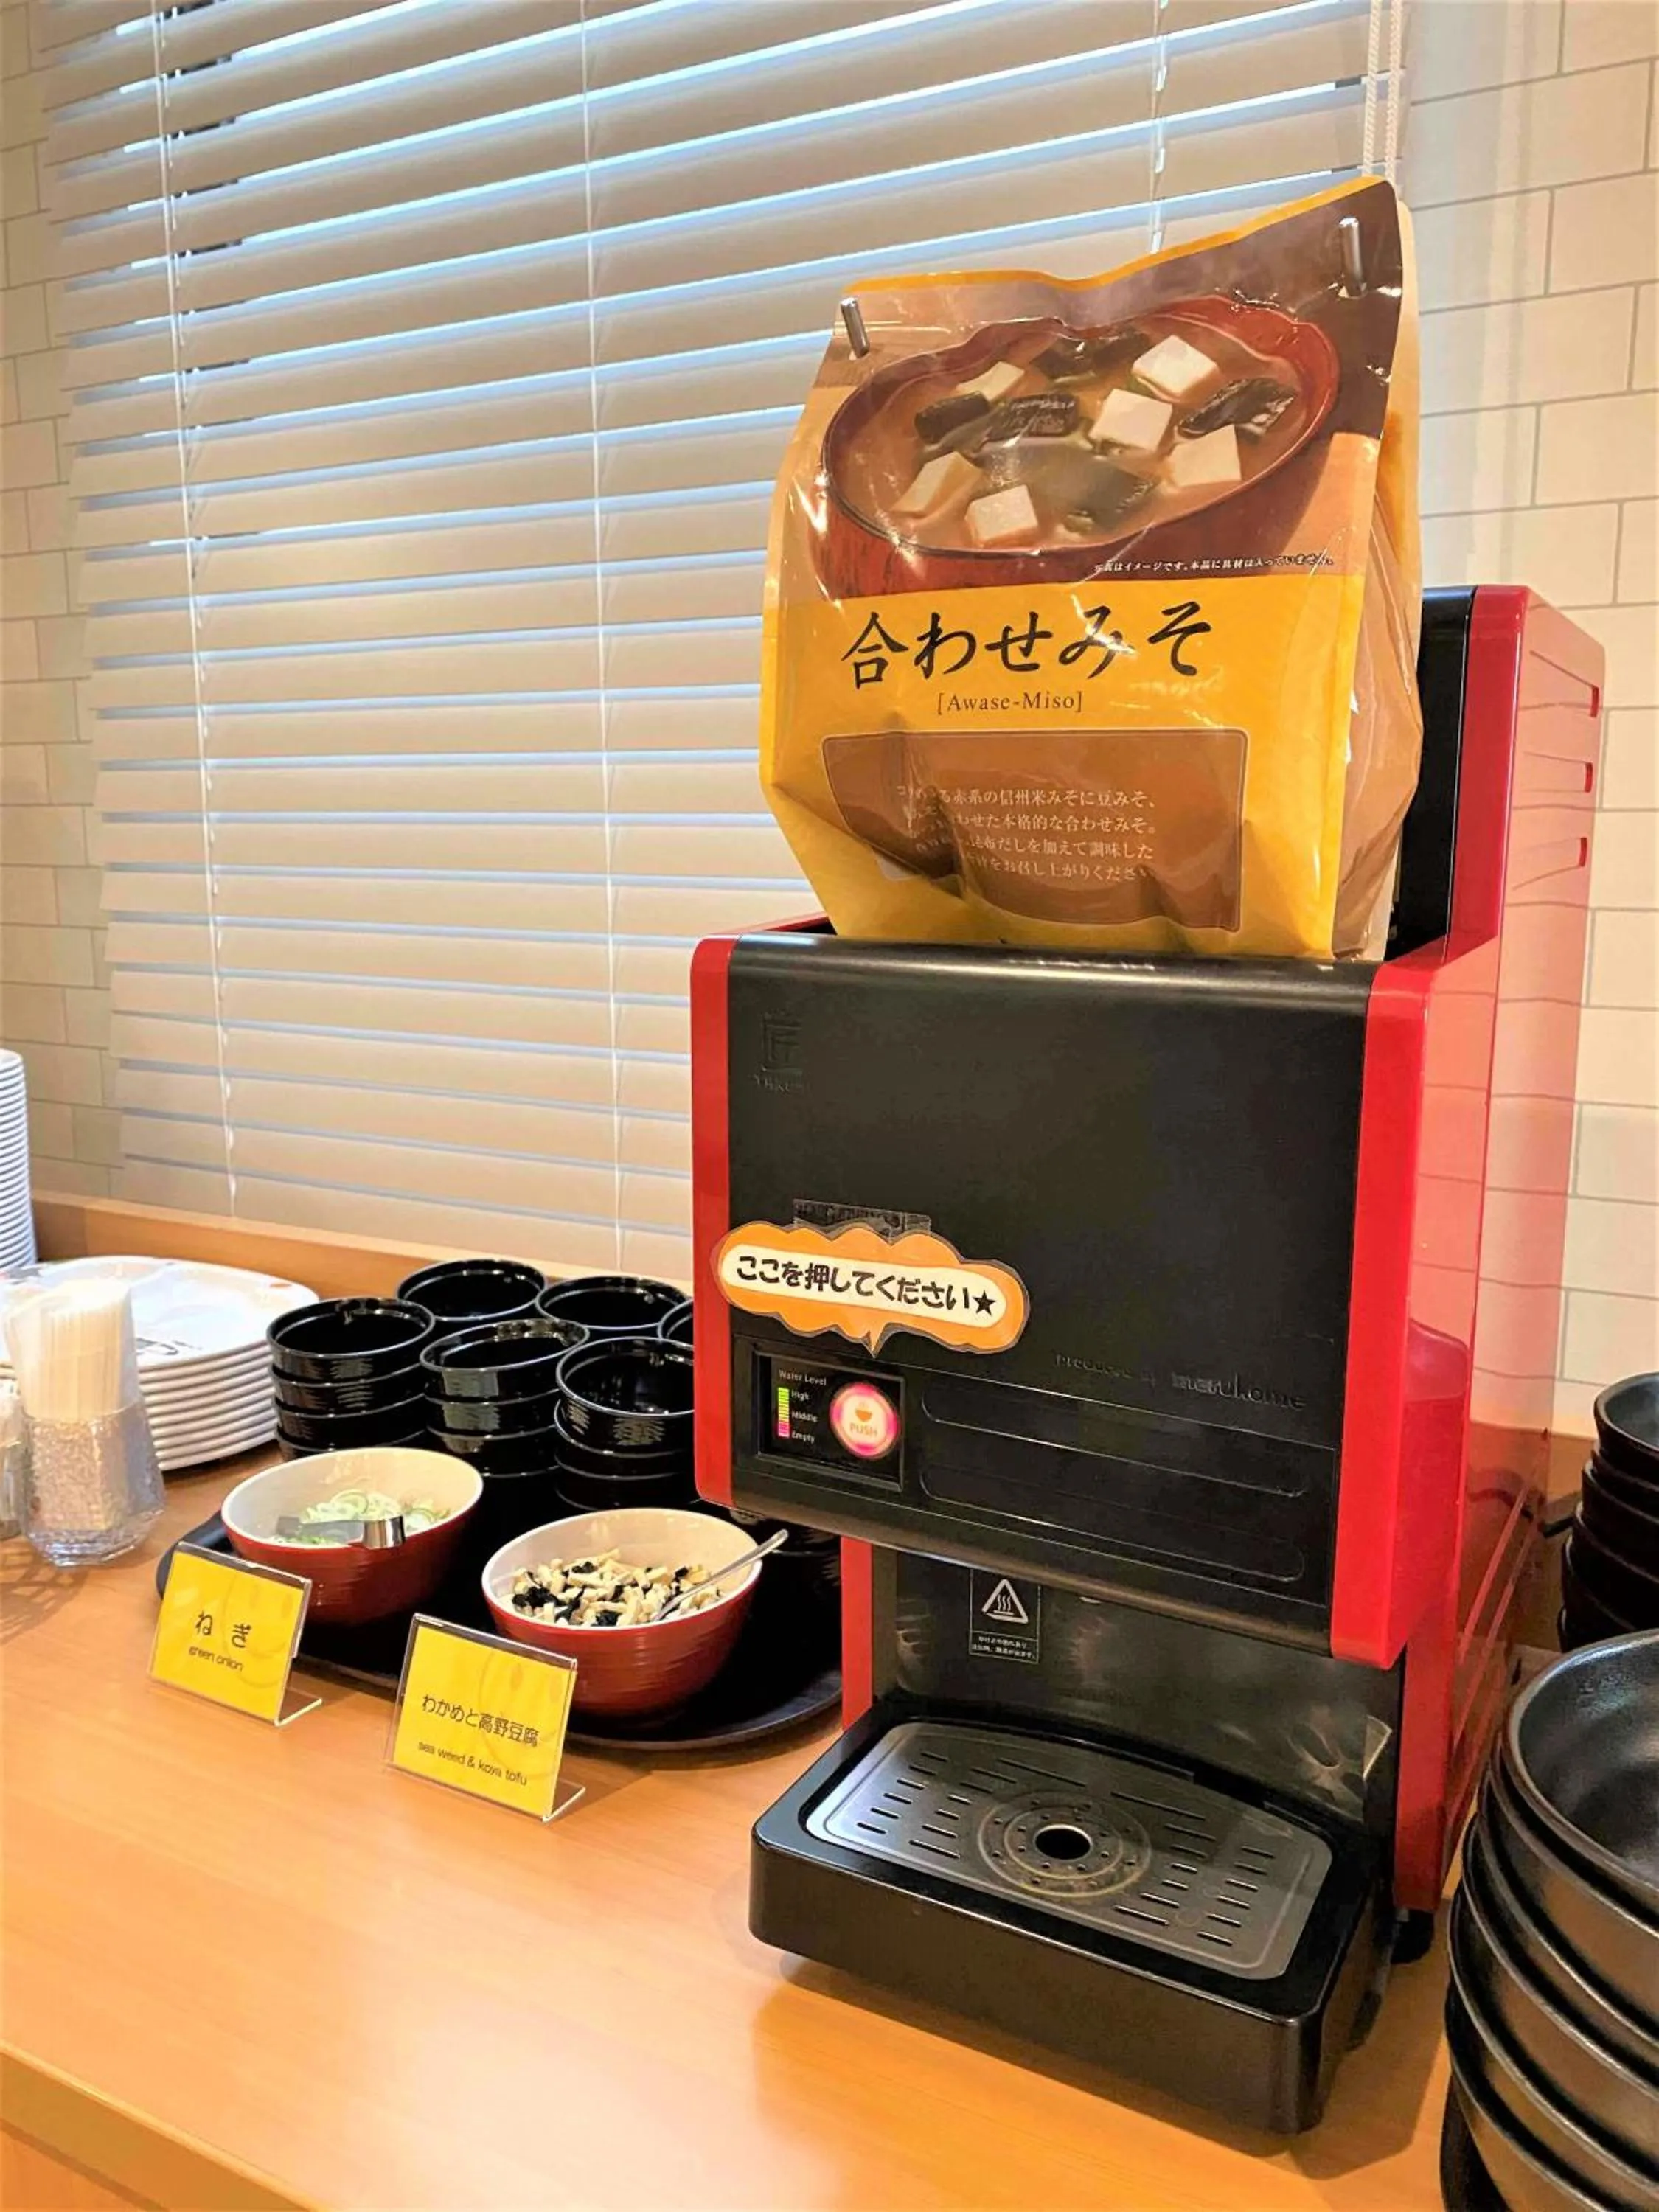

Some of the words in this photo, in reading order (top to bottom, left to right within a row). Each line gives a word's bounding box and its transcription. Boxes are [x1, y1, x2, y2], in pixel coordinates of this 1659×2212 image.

[841, 600, 1213, 689] 合わせみそ
[937, 691, 1083, 715] [Awase-Miso]
[804, 1374, 827, 1386] Level
[849, 1422, 878, 1437] PUSH
[188, 1646, 215, 1663] green
[216, 1655, 245, 1672] onion
[422, 1694, 539, 1748] わかめと高野豆腐
[418, 1741, 435, 1755] sea
[437, 1747, 466, 1766] weed
[466, 1755, 476, 1769] &
[478, 1760, 503, 1778] koya
[504, 1767, 528, 1787] tofu
